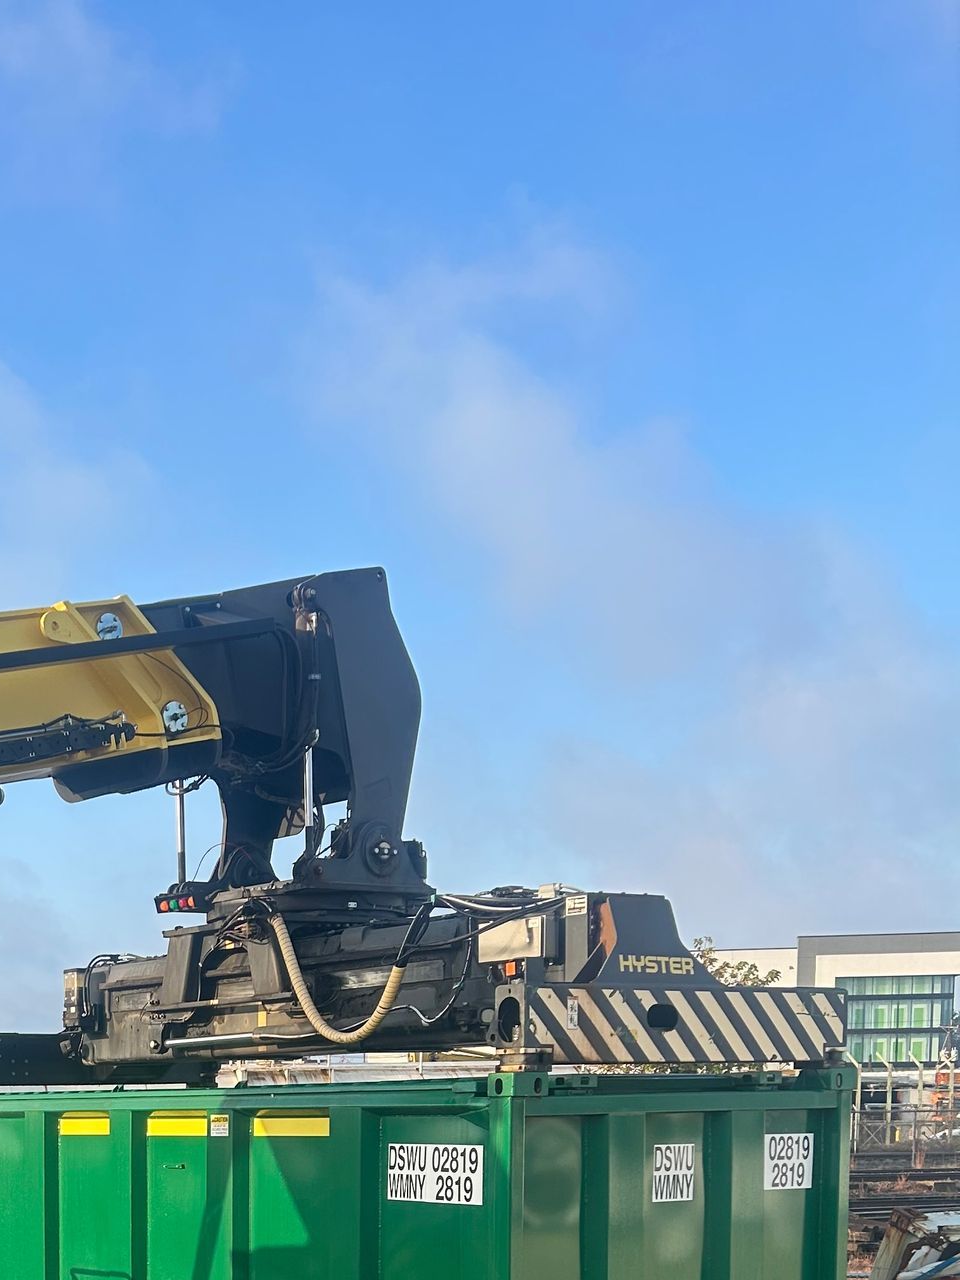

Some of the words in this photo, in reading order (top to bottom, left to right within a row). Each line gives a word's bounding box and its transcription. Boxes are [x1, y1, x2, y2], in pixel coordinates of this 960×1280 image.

[618, 954, 695, 975] HYSTER
[388, 1145, 428, 1172] DSWU
[431, 1146, 479, 1174] 02819
[654, 1145, 694, 1172] DSWU
[768, 1135, 810, 1161] 02819
[388, 1173, 426, 1200] WMNY
[435, 1174, 473, 1203] 2819
[653, 1173, 694, 1200] WMNY
[771, 1162, 805, 1188] 2819
